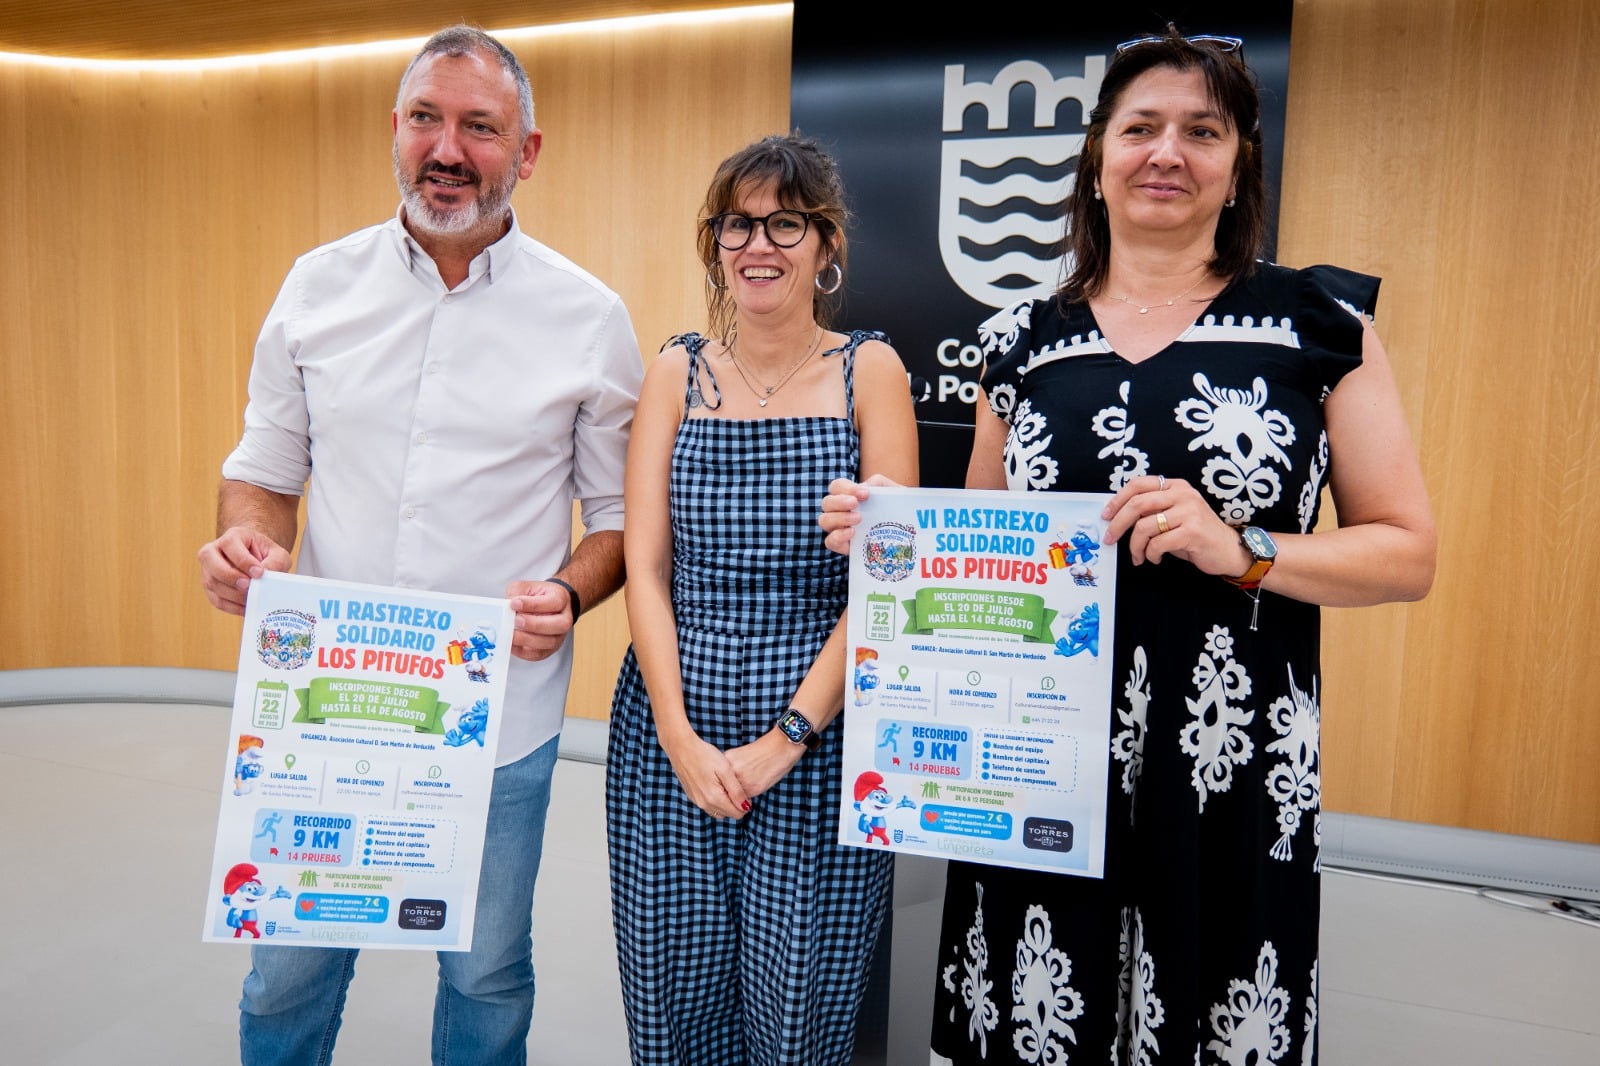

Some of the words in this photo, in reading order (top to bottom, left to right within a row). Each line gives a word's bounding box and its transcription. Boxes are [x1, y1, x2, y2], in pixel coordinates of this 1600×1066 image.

[916, 509, 937, 529] VI
[944, 509, 1049, 533] RASTREXO
[936, 533, 1035, 556] SOLIDARIO
[921, 557, 958, 579] LOS
[964, 559, 1048, 585] PITUFOS
[933, 592, 995, 604] INSCRIPCIONES
[997, 595, 1025, 607] DESDE
[319, 599, 340, 620] VI
[347, 600, 452, 631] RASTREXO
[944, 603, 954, 612] EL
[958, 603, 970, 612] 20
[973, 604, 984, 613] DE
[987, 605, 1014, 616] JULIO
[873, 612, 889, 625] 22
[928, 613, 956, 624] HASTA
[958, 614, 968, 623] EL
[971, 614, 982, 625] 14
[985, 616, 996, 626] DE
[998, 616, 1034, 630] AGOSTO
[336, 624, 436, 652] SOLIDARIO
[318, 647, 356, 669] LOS
[362, 650, 446, 680] PITUFOS
[328, 682, 391, 694] INSCRIPCIONES
[393, 687, 420, 699] DESDE
[904, 684, 921, 692] SALIDA
[949, 688, 963, 696] HORA
[972, 690, 998, 698] COMIENZO
[261, 699, 280, 713] 22
[339, 692, 349, 702] EL
[352, 694, 364, 703] 20
[368, 695, 380, 705] DE
[382, 696, 408, 708] JULIO
[321, 702, 350, 713] HASTA
[353, 704, 362, 713] EL
[366, 705, 376, 715] 14
[379, 706, 390, 716] DE
[392, 707, 426, 722] AGOSTO
[912, 726, 968, 742] RECORRIDO
[913, 742, 924, 758] 9
[931, 742, 957, 762] KM
[1025, 746, 1044, 754] equipo
[909, 762, 920, 772] 14
[922, 763, 960, 776] PRUEBAS
[270, 772, 288, 780] LUGAR
[289, 773, 308, 781] SALIDA
[360, 778, 384, 786] COMIENZO
[1021, 778, 1056, 786] componentes
[294, 815, 351, 830] RECORRIDO
[987, 813, 994, 822] 7
[996, 814, 1004, 823] €
[1028, 828, 1069, 838] TORRES
[293, 831, 306, 847] 9
[312, 831, 340, 850] KM
[288, 852, 298, 862] 14
[302, 852, 342, 864] PRUEBAS
[364, 898, 372, 906] 7
[372, 898, 380, 907] €
[404, 908, 442, 916] TORRES
